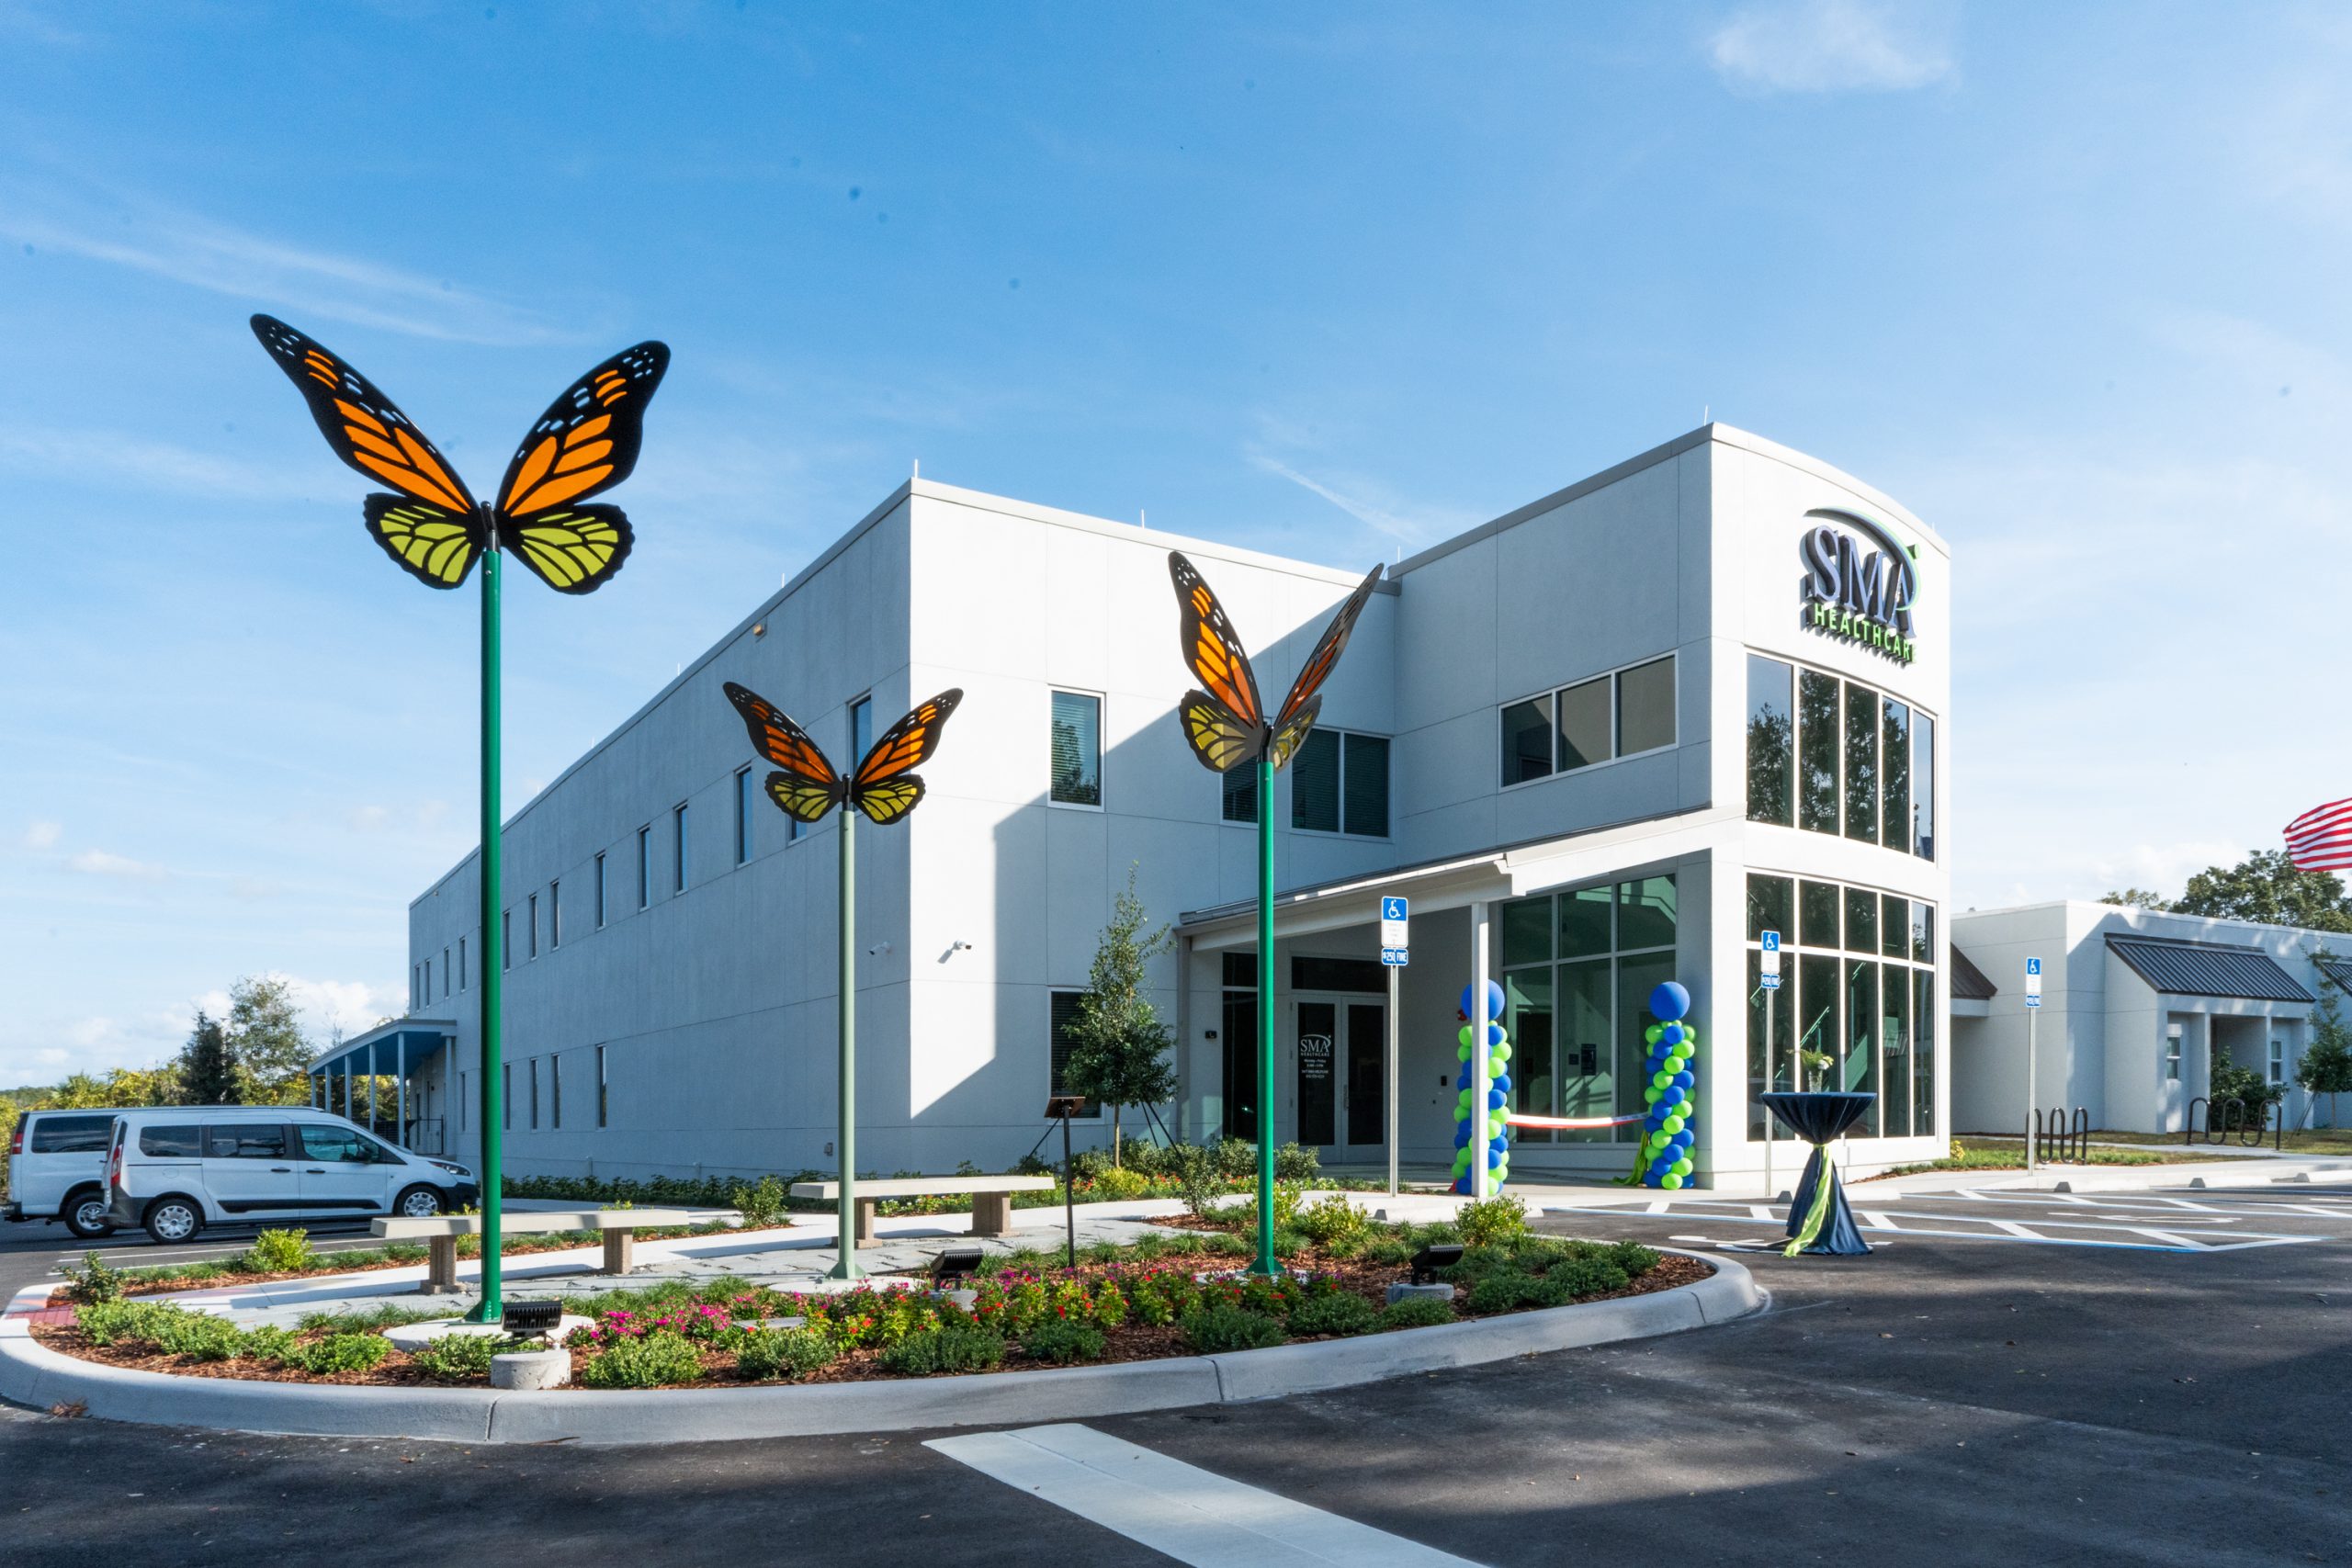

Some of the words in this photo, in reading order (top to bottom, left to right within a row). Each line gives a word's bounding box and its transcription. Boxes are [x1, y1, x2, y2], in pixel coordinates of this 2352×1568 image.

[1803, 525, 1917, 637] SMA
[1812, 603, 1917, 665] HEALTHCARE
[1300, 1038, 1329, 1053] SMA
